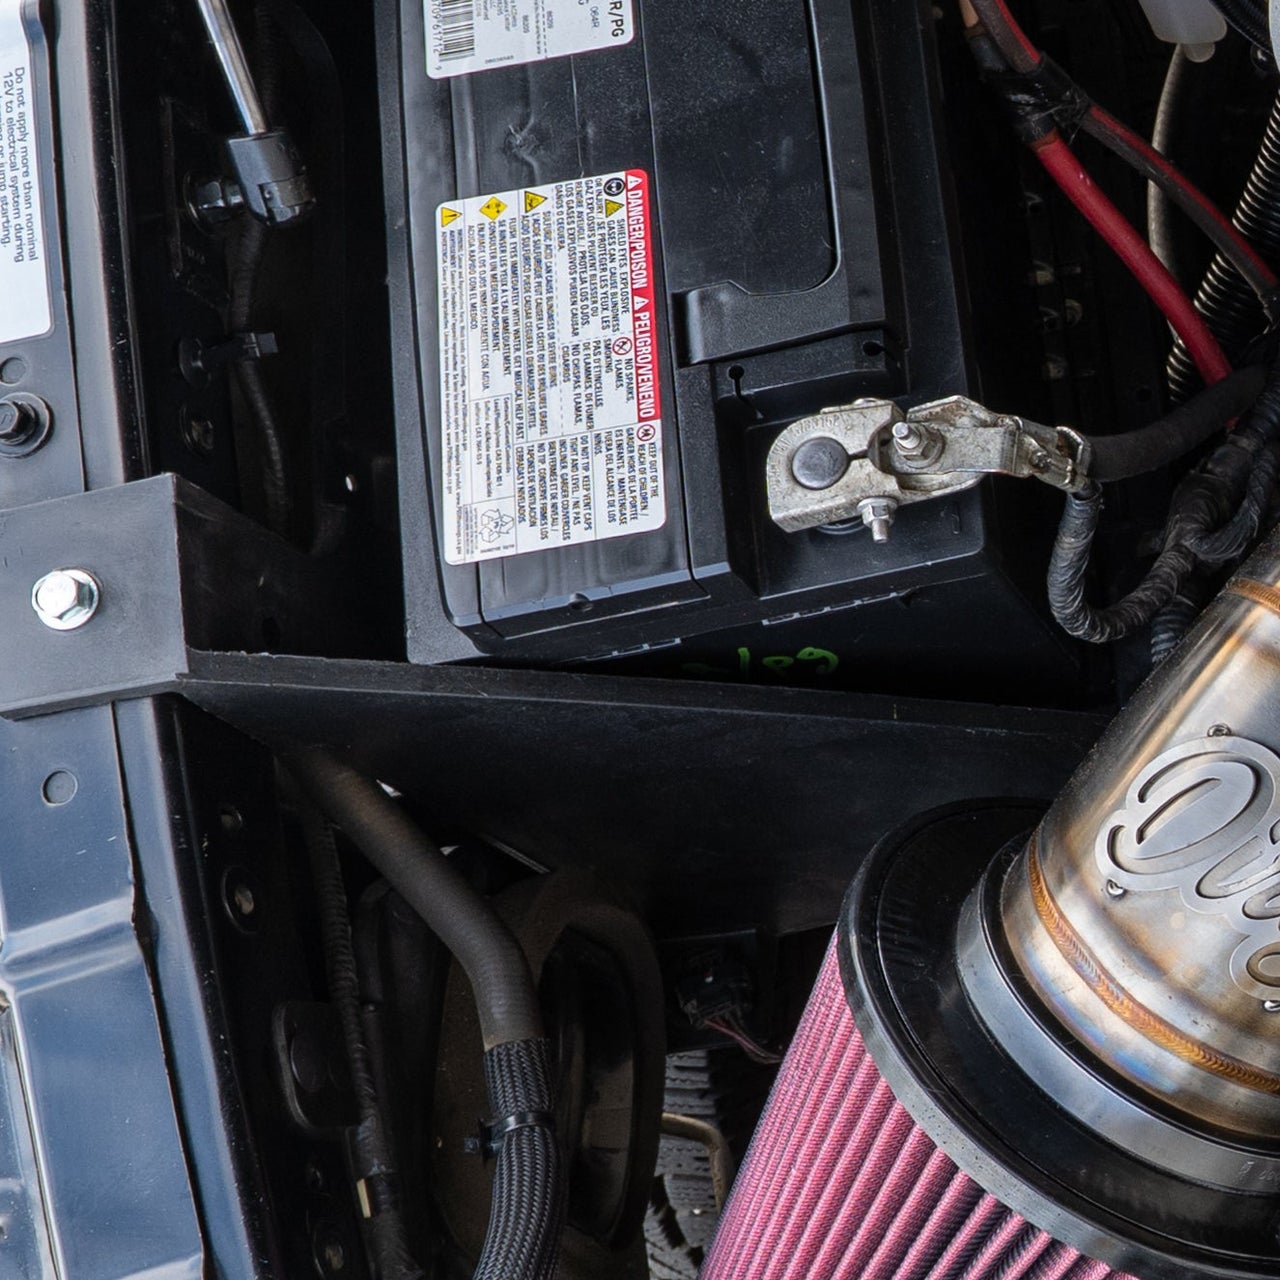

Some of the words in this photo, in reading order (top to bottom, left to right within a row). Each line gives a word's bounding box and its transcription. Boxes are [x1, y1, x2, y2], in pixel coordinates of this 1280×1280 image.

[2, 72, 13, 98] 12V
[14, 67, 25, 83] Do
[4, 100, 14, 113] to
[15, 87, 25, 108] not
[14, 111, 29, 142] apply
[5, 116, 19, 171] electrical
[19, 145, 29, 177] more
[7, 175, 21, 219] system
[22, 181, 34, 209] than
[564, 182, 573, 197] LOS
[584, 179, 593, 195] GAZ
[565, 198, 574, 226] GASES
[594, 188, 604, 214] INJURY
[508, 217, 516, 239] FLUSH
[585, 196, 595, 238] EXPLOSIFS
[596, 221, 605, 230] SE
[11, 222, 25, 263] during
[24, 212, 38, 261] nominal
[606, 219, 616, 246] GASES
[616, 218, 626, 246] SHIELD
[627, 189, 647, 289] DANGER/POISON
[508, 241, 517, 259] EYES
[566, 227, 577, 276] EXPLOSIVOS
[587, 239, 597, 272] PEUVENT
[607, 247, 617, 263] CAN
[577, 250, 587, 285] PROTEJA
[608, 266, 618, 290] CAUSE
[509, 259, 519, 307] IMMEDIATELY
[568, 276, 578, 306] PUEDEN
[589, 273, 598, 305] BLESSER
[599, 274, 608, 289] LES
[619, 271, 630, 314] EXPLOSIVE
[579, 286, 588, 302] LOS
[511, 306, 520, 327] WITH
[570, 307, 580, 337] CAUSAR
[590, 305, 599, 317] OU
[610, 291, 620, 332] BLINDNESS
[601, 315, 610, 330] LES
[571, 343, 580, 356] NO
[581, 341, 590, 351] DE
[592, 339, 601, 356] PAS
[603, 338, 612, 374] SMOKING
[513, 354, 522, 369] GET
[561, 345, 571, 383] CIGARROS
[623, 357, 632, 370] NO
[633, 311, 654, 418] PELIGRO/VENENO
[513, 369, 523, 402] MEDICAL
[584, 392, 593, 403] DE
[515, 402, 524, 421] HELP
[584, 404, 594, 430] FUMER
[580, 445, 589, 460] NOT
[636, 443, 646, 466] REACH
[647, 441, 656, 459] KEEP
[638, 466, 646, 476] OF
[648, 459, 657, 473] OUT
[581, 474, 590, 493] KEEP
[649, 474, 658, 484] OF
[582, 492, 591, 511] VENT
[649, 484, 658, 498] THE
[583, 511, 592, 531] CAPS
